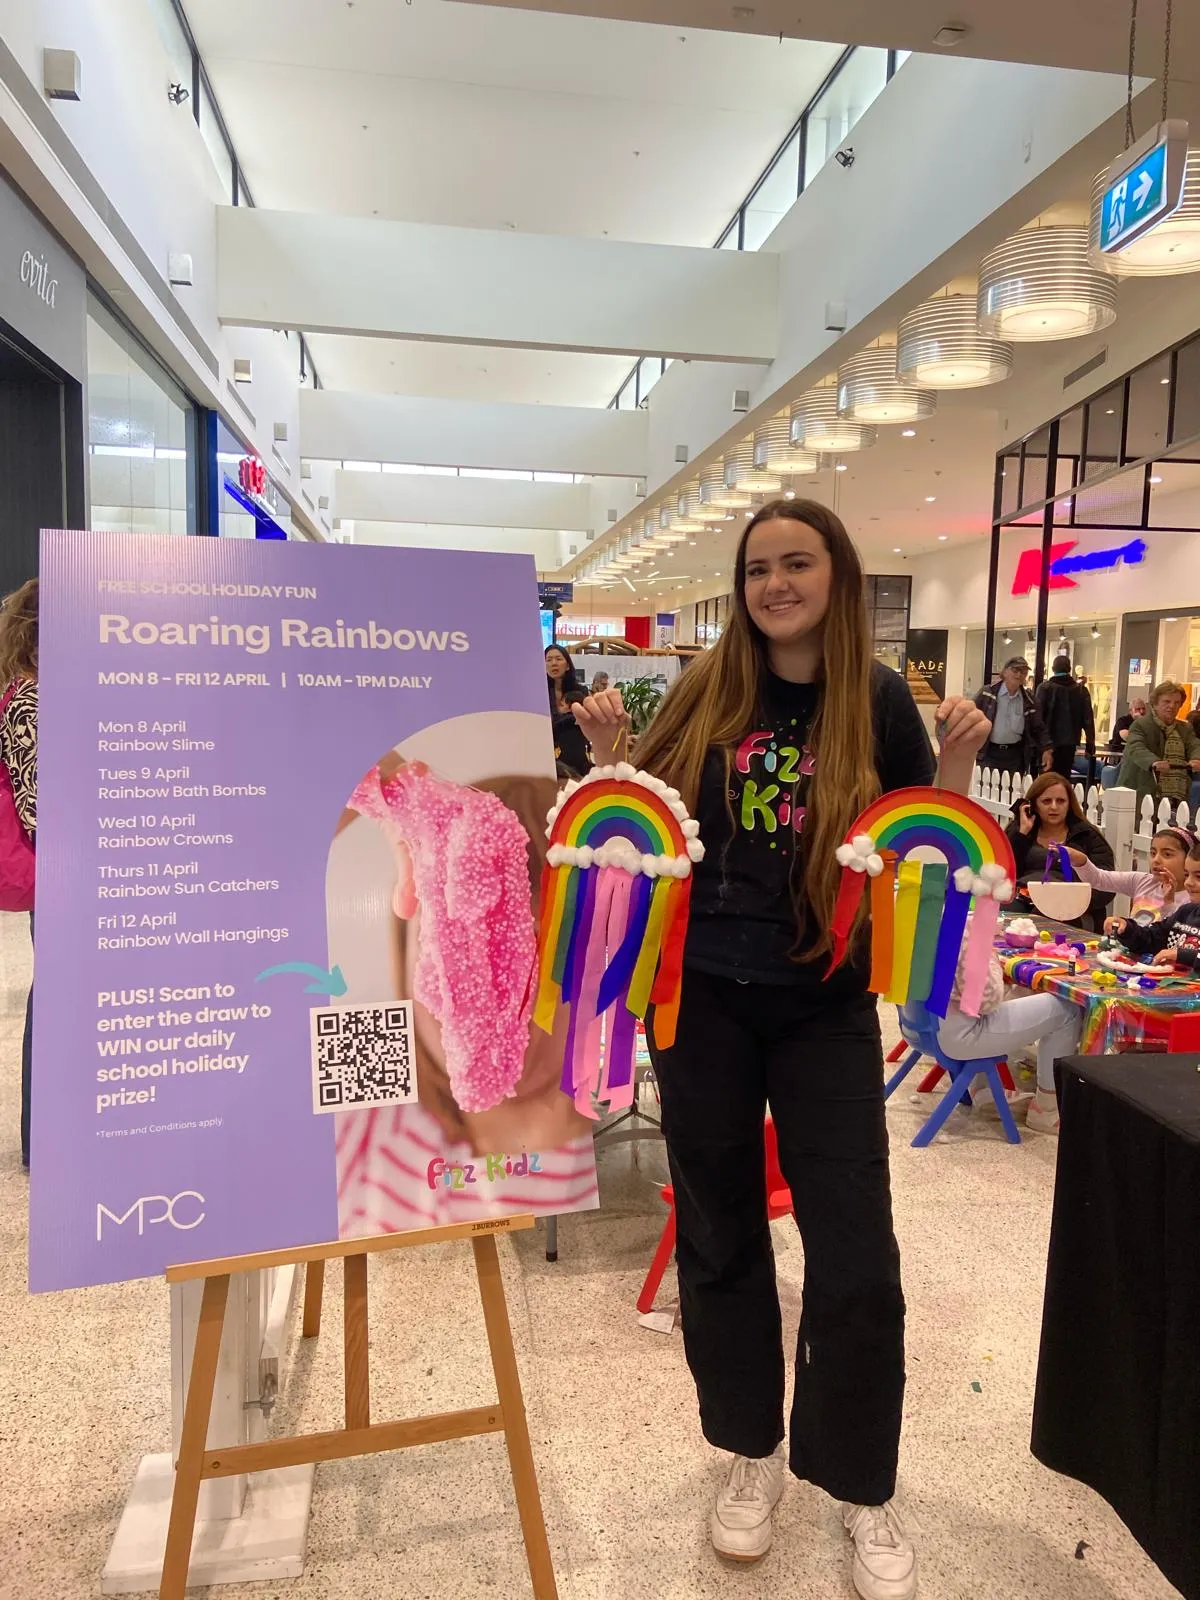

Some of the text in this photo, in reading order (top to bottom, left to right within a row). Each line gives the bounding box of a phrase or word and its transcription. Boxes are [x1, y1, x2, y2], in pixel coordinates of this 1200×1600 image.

[20, 250, 58, 309] evita
[98, 580, 317, 599] FREE SCHOOL HOLIDAY FUN
[99, 614, 470, 654] Roaring Rainbows
[557, 623, 599, 637] idstuff
[911, 660, 944, 672] FADE
[98, 672, 144, 685] MON
[147, 672, 159, 686] 8
[175, 673, 201, 686] FRI
[203, 673, 221, 686] 12
[223, 673, 270, 686] APRIL
[298, 674, 342, 687] 10AM
[356, 675, 386, 688] 1PM
[389, 676, 433, 689] DAILY
[99, 721, 187, 735] Mon 8 April
[99, 738, 215, 752] Rainbow Slime
[99, 766, 190, 781] Tues 9 April
[99, 784, 267, 799] Rainbow Bath Bombs
[99, 813, 196, 830] Wed 10 April
[99, 833, 234, 849] Rainbow Crowns
[98, 861, 199, 879] Thurs 11 April
[98, 879, 280, 899] Rainbow Sun Catchers
[98, 911, 177, 930] Fri 12 April
[98, 927, 289, 950] Rainbow Wall Hangings
[97, 983, 235, 1008] PLUS! Scan to
[97, 1004, 272, 1032] enter the draw to
[97, 1029, 236, 1057] WIN our daily
[96, 1054, 250, 1082] school holiday
[96, 1086, 156, 1114] prize!
[130, 1126, 147, 1136] and
[149, 1120, 197, 1133] Conditions
[427, 1151, 543, 1191] Fizz Kidz
[97, 1190, 206, 1241] MPC
